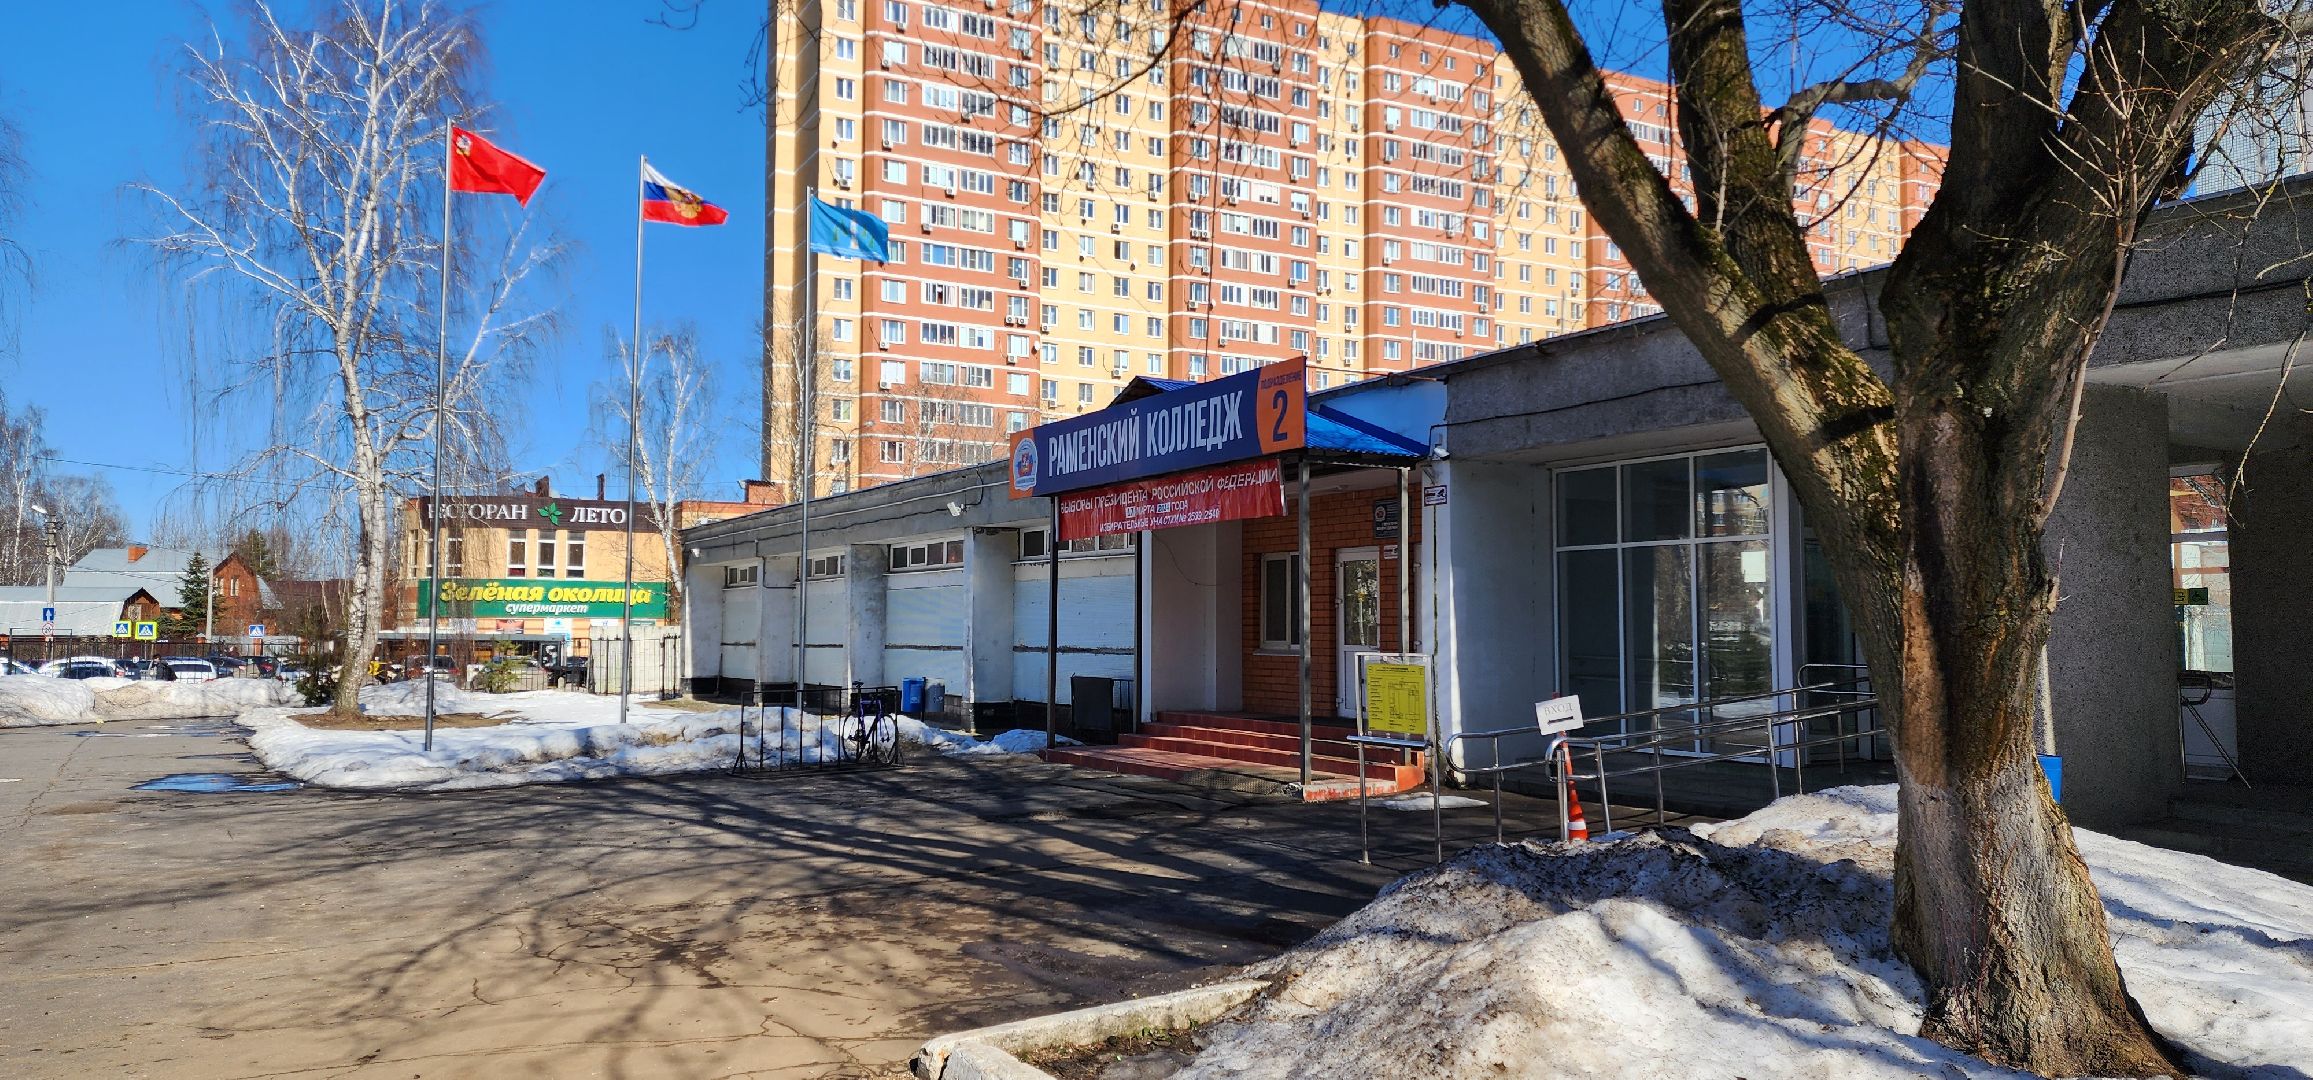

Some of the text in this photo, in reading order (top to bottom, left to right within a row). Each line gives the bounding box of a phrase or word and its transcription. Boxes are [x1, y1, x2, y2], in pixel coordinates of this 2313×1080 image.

[1272, 390, 1288, 442] 2
[1048, 408, 1140, 477] РАМЕНСКИЙ
[1146, 390, 1243, 458] КОЛЛЕДЖ
[1061, 468, 1279, 514] ВЫБОРЫ ПРЕЗИДЕНТА РОССИЙСКОЙ ФЕДЕРАЦИИ
[1171, 500, 1188, 511] ГОДА
[570, 507, 628, 524] ЛЕТО
[1099, 517, 1149, 533] ИЗБИРАТЕЛЬНЫЕ
[439, 581, 545, 603] Зелёная
[505, 603, 589, 616] супермаркет
